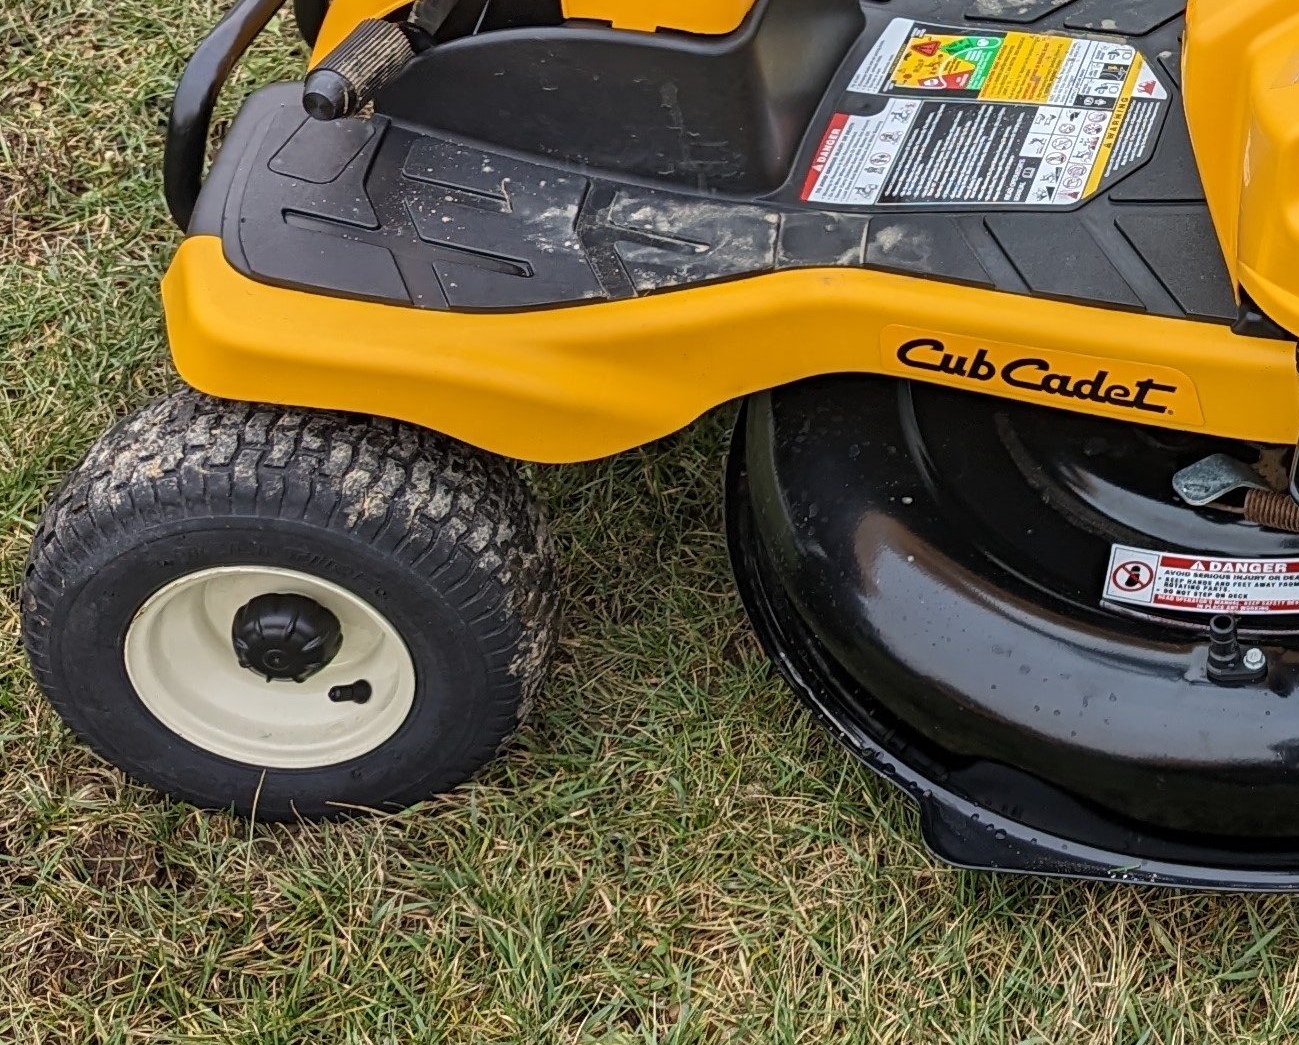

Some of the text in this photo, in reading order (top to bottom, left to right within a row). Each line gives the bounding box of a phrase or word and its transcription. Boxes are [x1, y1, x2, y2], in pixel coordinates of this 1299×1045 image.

[1106, 97, 1128, 140] WARNING
[816, 128, 841, 166] DANGER
[896, 338, 1178, 414] Cub Cadet
[1164, 569, 1191, 577] AVOID
[1193, 572, 1231, 580] SERIOUS
[1209, 561, 1288, 573] DANGER
